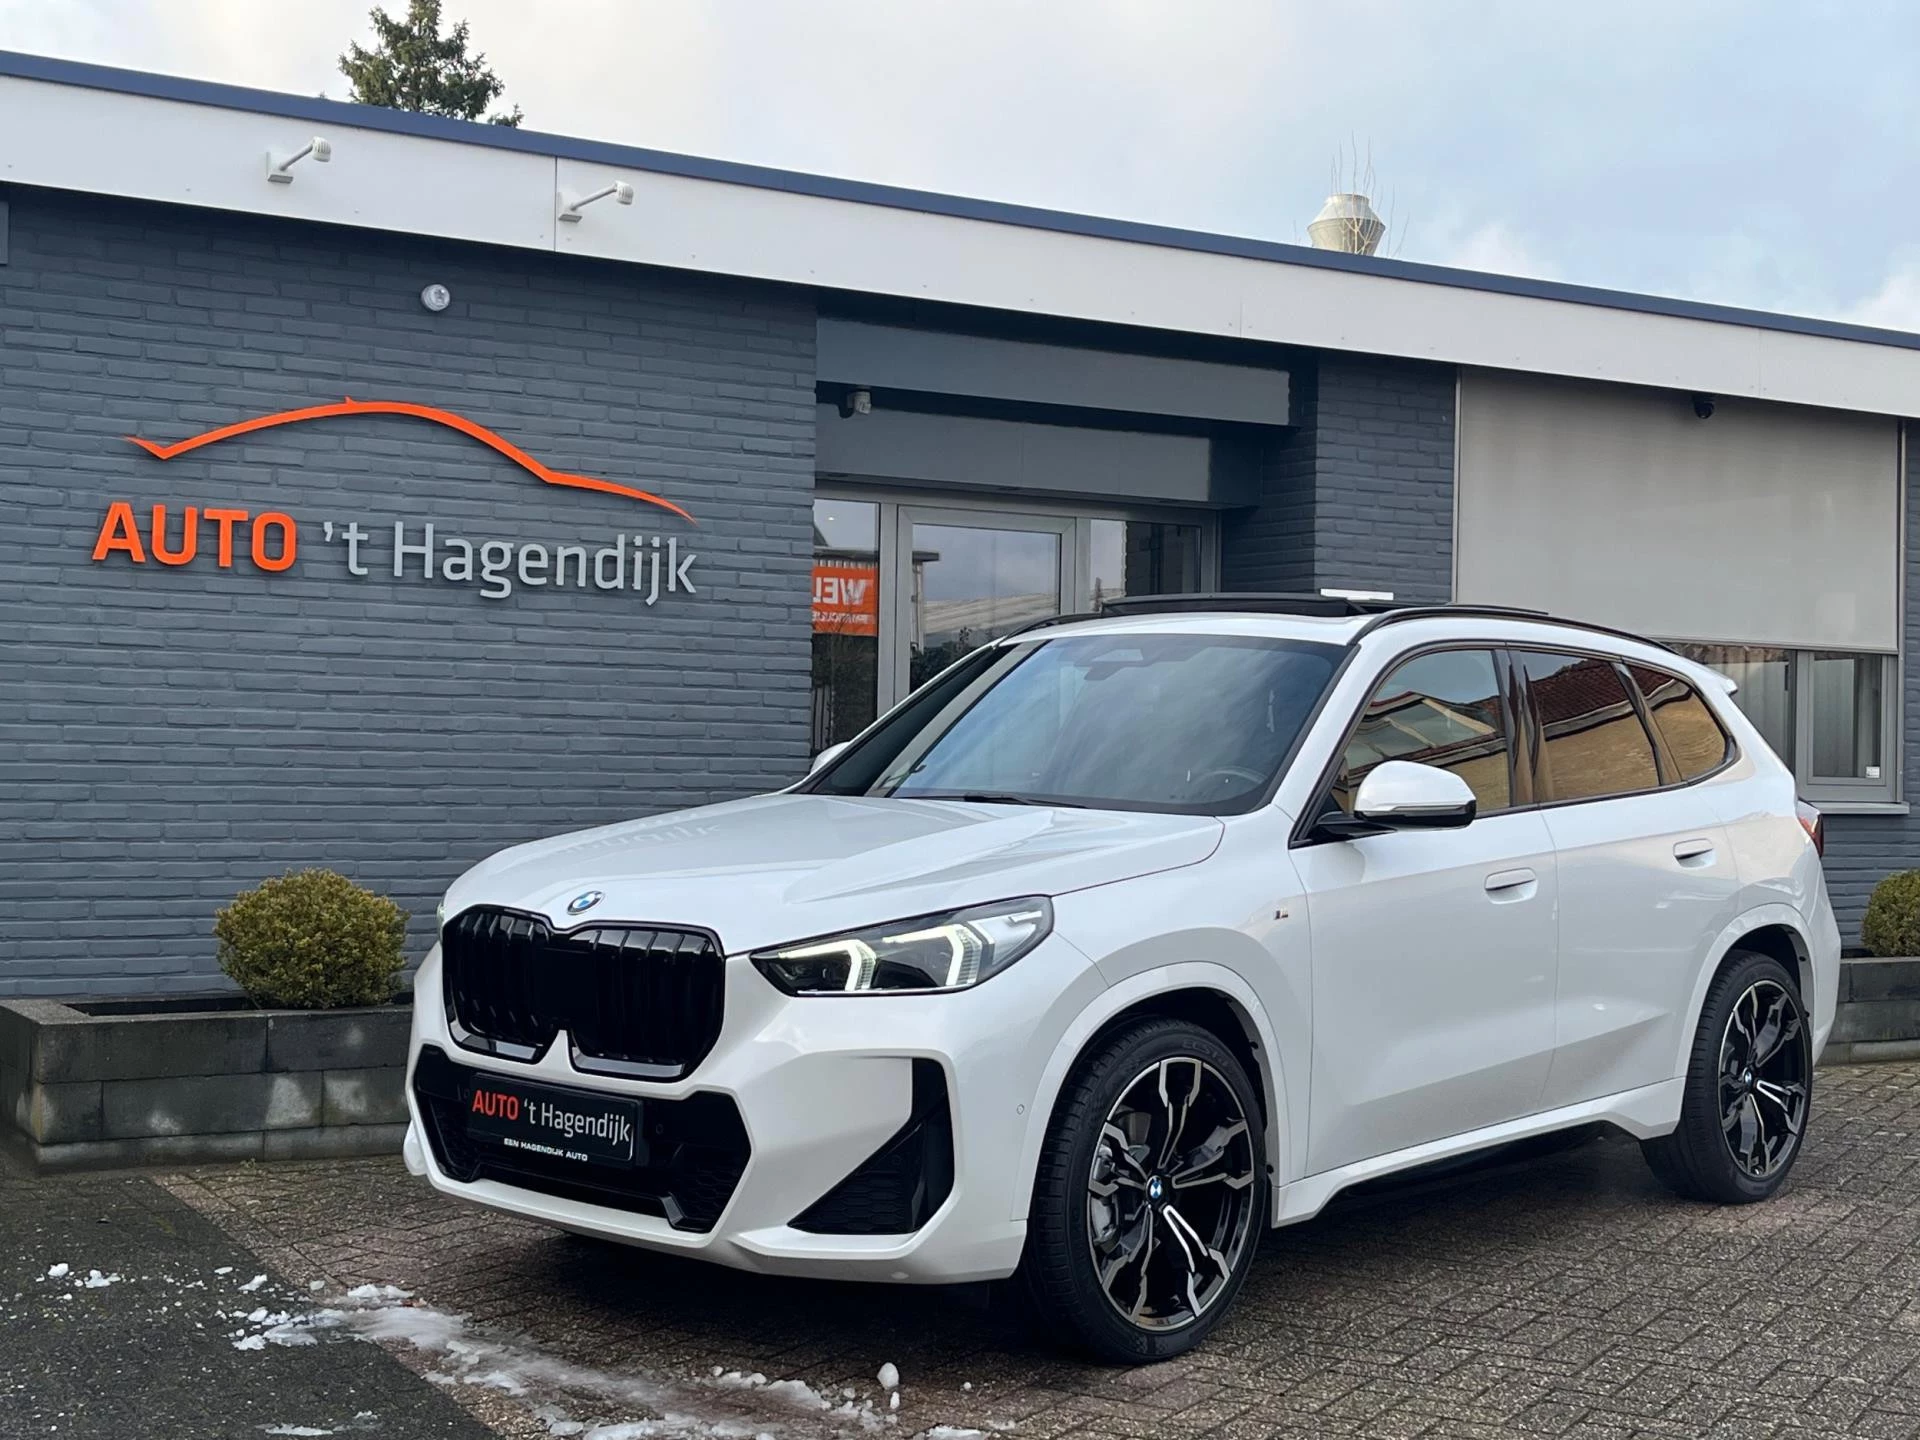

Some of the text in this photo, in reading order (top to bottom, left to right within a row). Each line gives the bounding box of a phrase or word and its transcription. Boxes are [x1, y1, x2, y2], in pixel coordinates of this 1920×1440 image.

[92, 502, 297, 573] AUTO
[392, 520, 698, 606] Hagendijk
[472, 1089, 519, 1121] AUTO
[541, 1101, 632, 1146] Hagendijk
[503, 1137, 588, 1162] EEN HAGENDIJK AUTO
